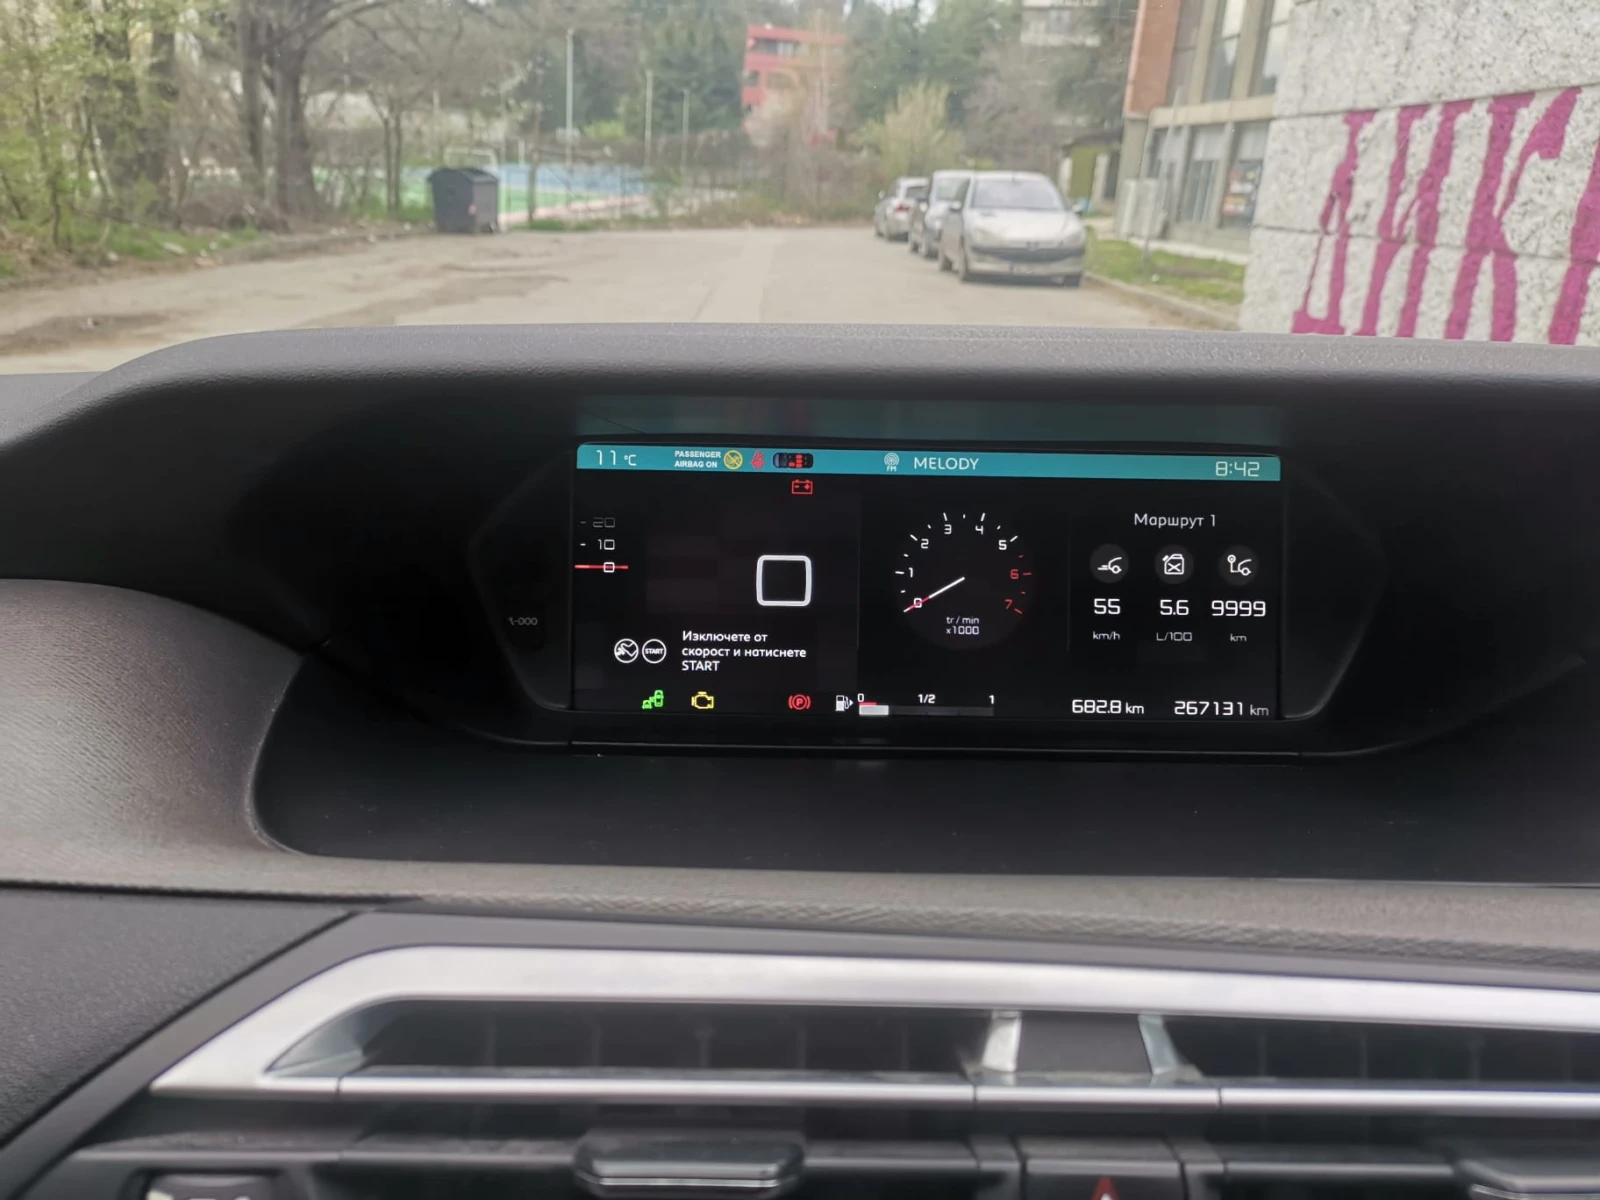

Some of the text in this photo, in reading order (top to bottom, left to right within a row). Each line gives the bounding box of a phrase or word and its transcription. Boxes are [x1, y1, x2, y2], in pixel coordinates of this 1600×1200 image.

[596, 449, 617, 466] 11
[673, 450, 722, 459] PASSENGER
[673, 459, 718, 469] AIRBAG ON
[912, 456, 980, 470] MELODY
[1215, 461, 1261, 477] 8:42
[592, 516, 616, 528] 20
[1133, 512, 1217, 529] Маршрут 1
[943, 523, 953, 535] 3
[974, 524, 985, 535] 4
[597, 538, 616, 551] 10
[920, 537, 930, 550] 2
[998, 539, 1008, 551] 5
[908, 566, 915, 579] 1
[1010, 568, 1020, 580] 6
[1004, 598, 1014, 610] 7
[1093, 598, 1121, 615] 55
[1159, 599, 1190, 616] 5.6
[1211, 600, 1267, 617] 9999
[682, 630, 768, 643] Изключете от
[945, 625, 980, 636] x1000
[1092, 630, 1121, 641] km/h
[1155, 631, 1194, 642] L/100
[1229, 633, 1248, 643] km
[644, 647, 665, 656] START
[681, 647, 807, 659] скорост и натиснете
[681, 660, 720, 672] START
[857, 693, 865, 703] 0
[917, 693, 936, 705] 1/2
[988, 694, 996, 705] 1
[1071, 699, 1145, 715] 682.8 km
[1173, 700, 1270, 717] 267131 km
